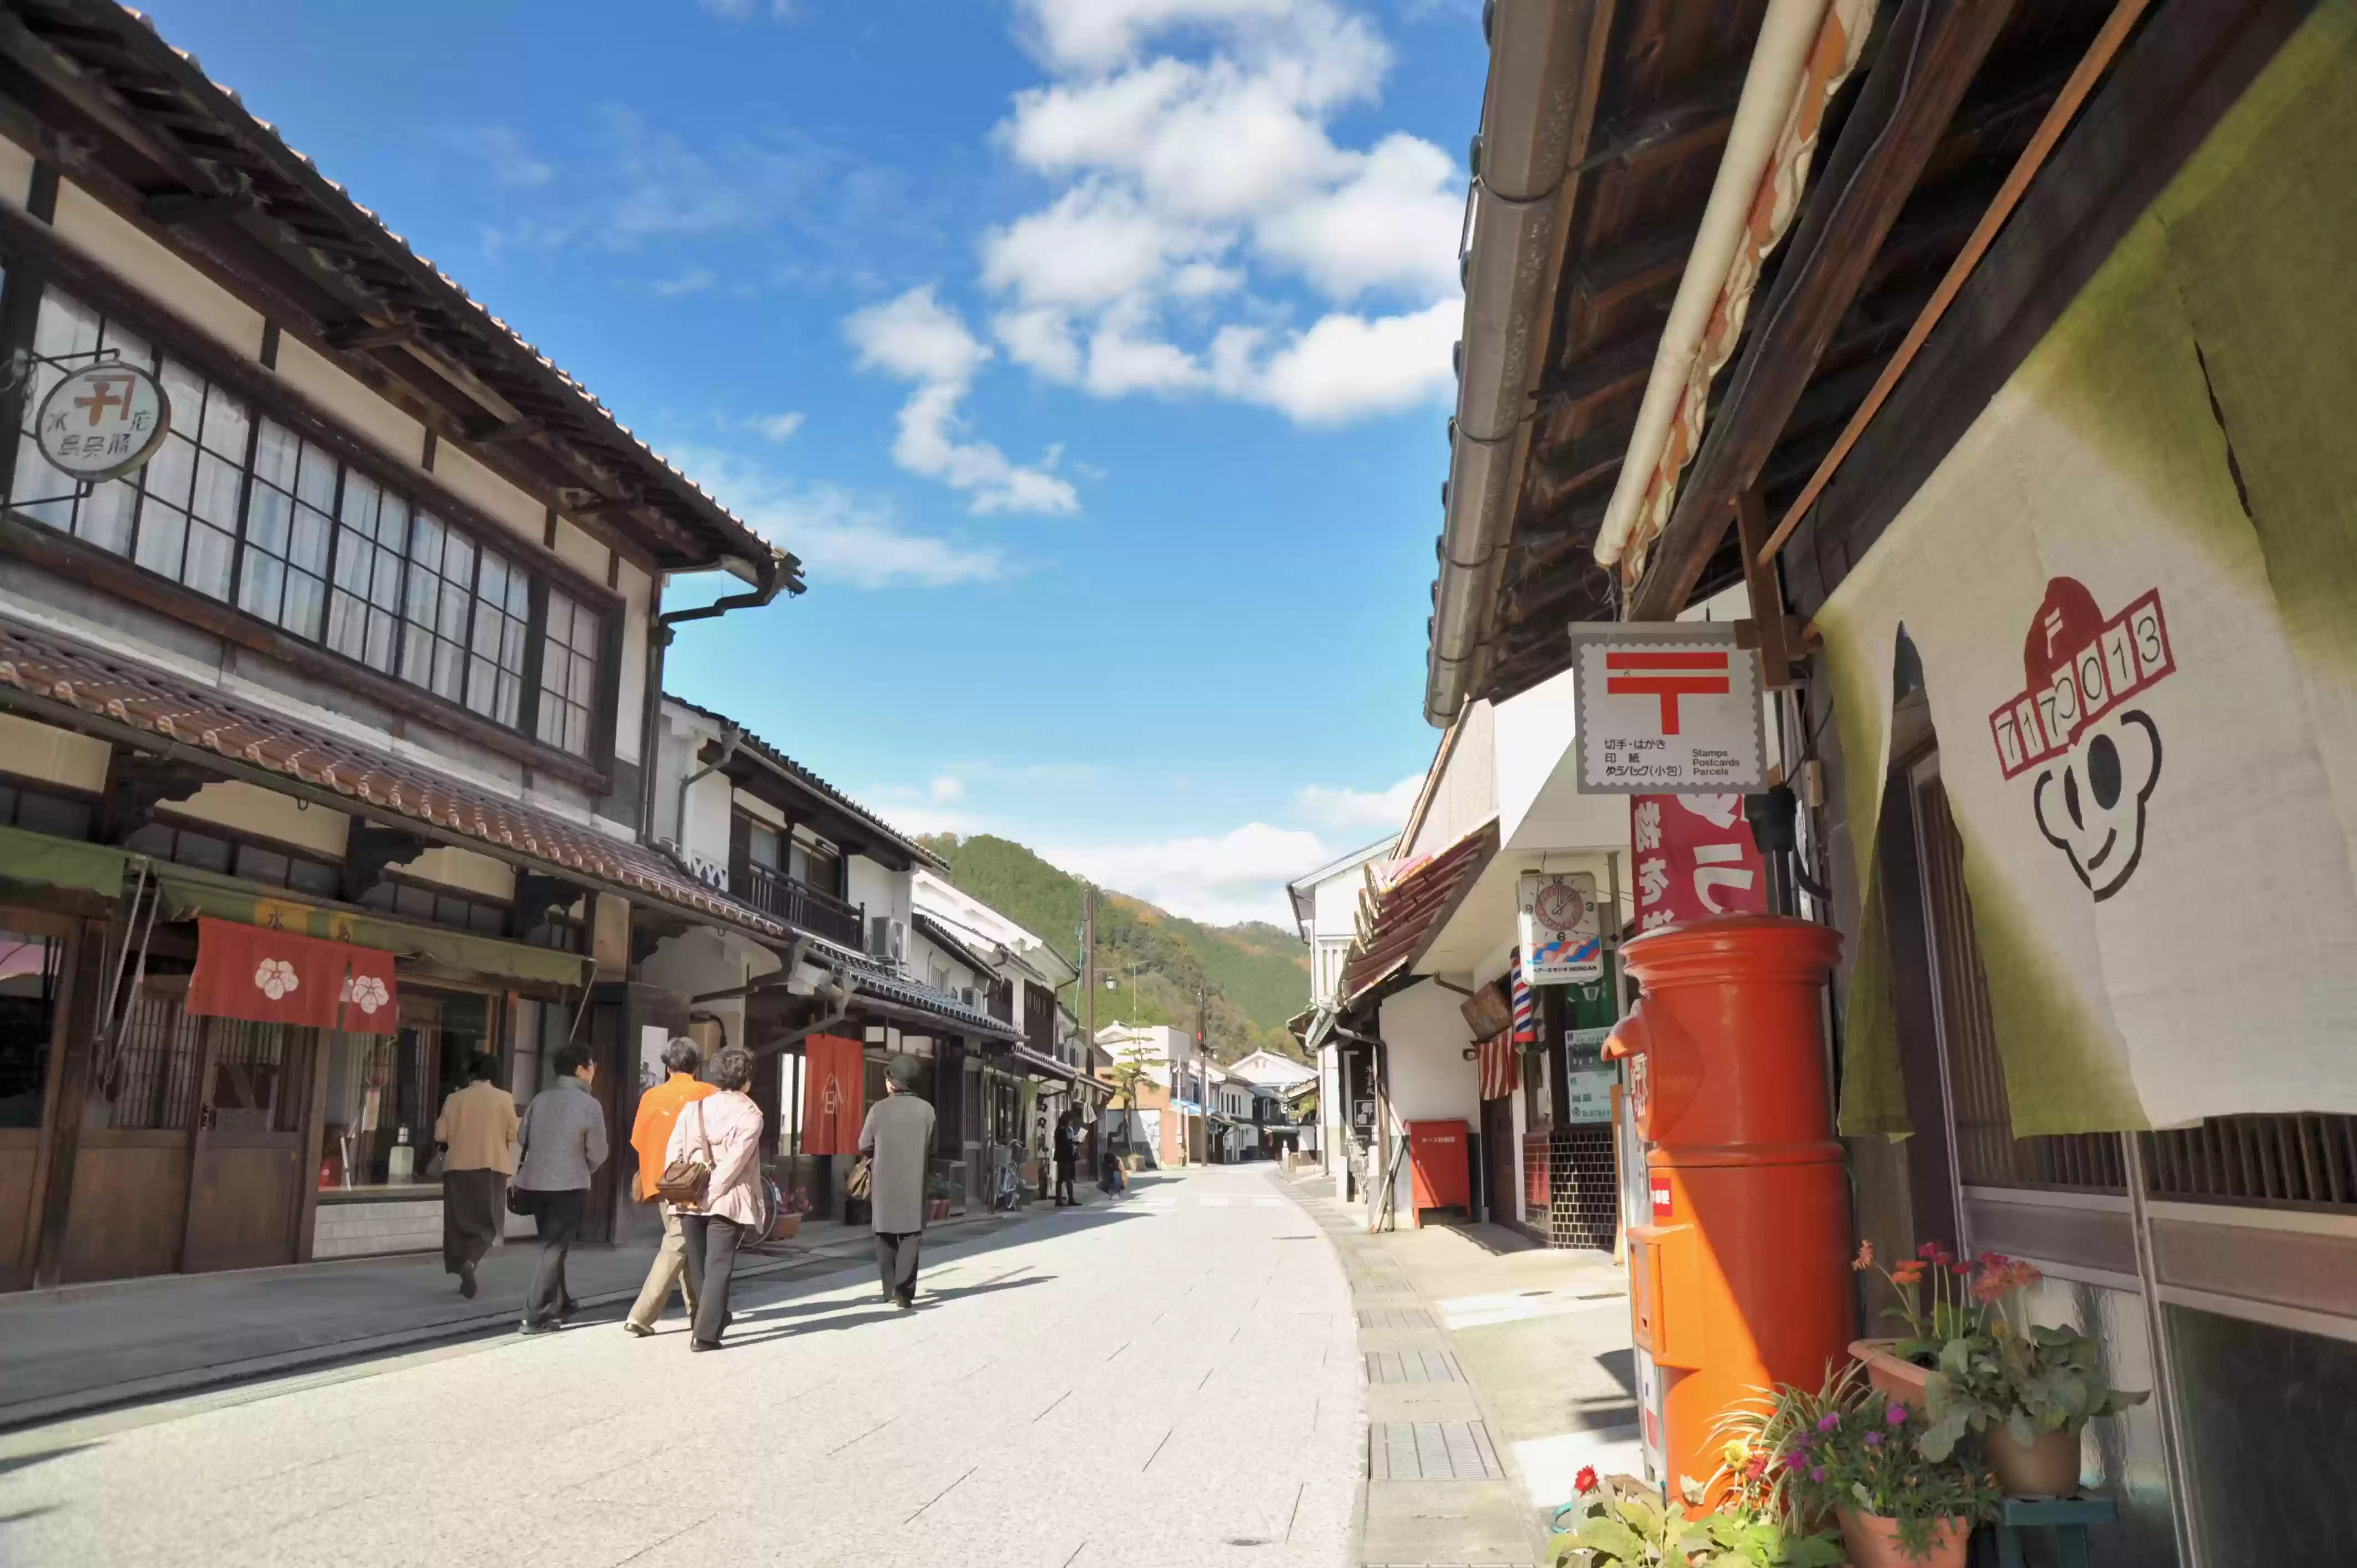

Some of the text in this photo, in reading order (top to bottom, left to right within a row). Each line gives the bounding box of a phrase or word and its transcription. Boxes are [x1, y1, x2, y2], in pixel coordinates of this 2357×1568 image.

[1692, 748, 1728, 758] Stamps
[1692, 758, 1740, 767] Postcards
[1693, 767, 1729, 776] Parcels
[1557, 932, 1566, 941] 6
